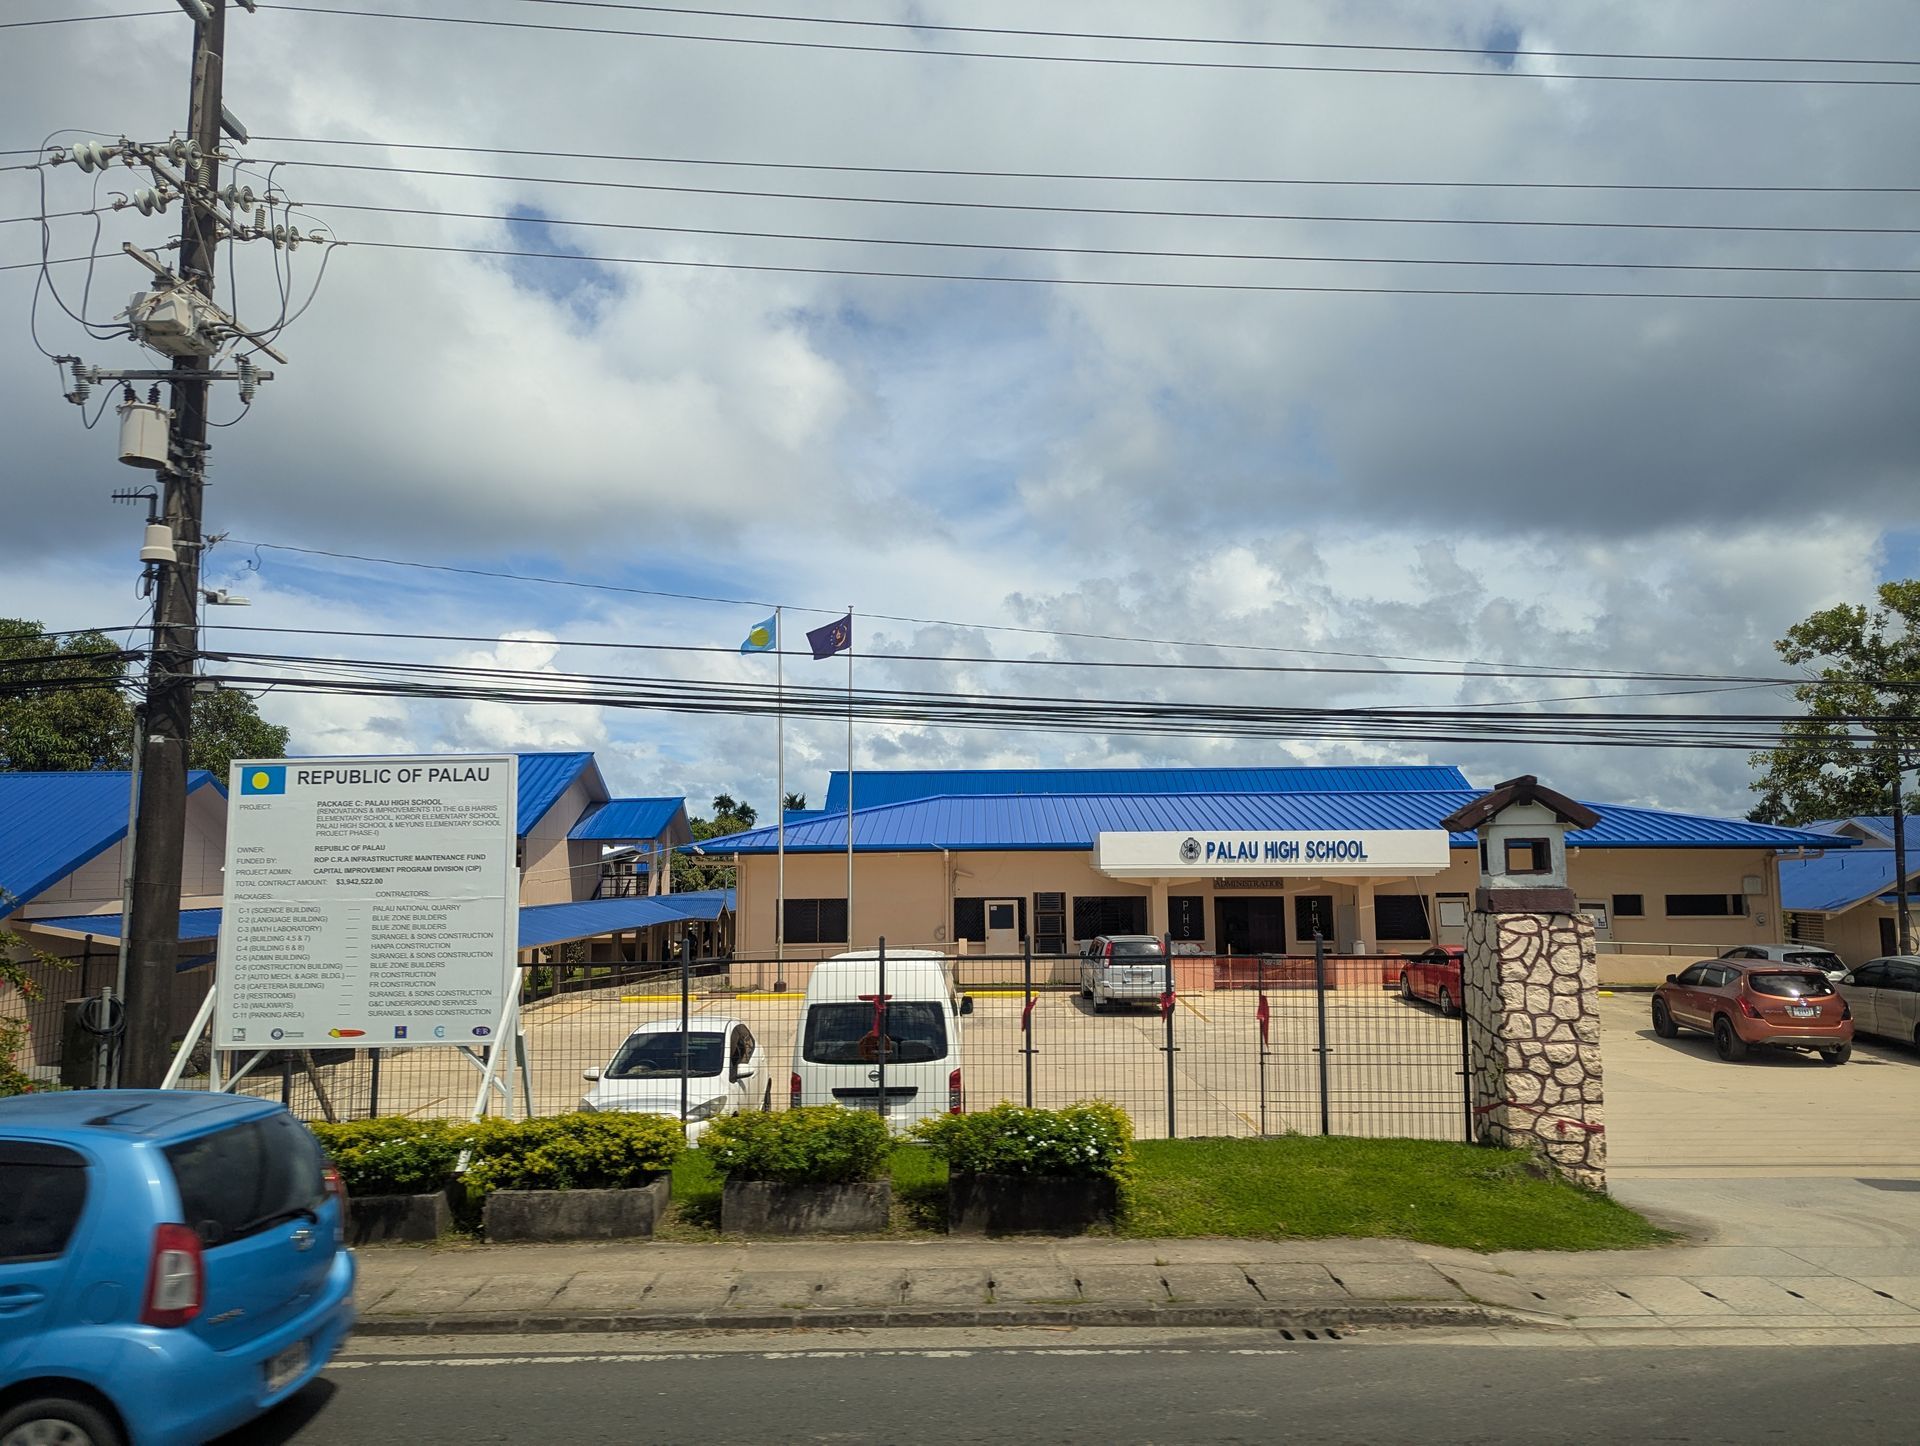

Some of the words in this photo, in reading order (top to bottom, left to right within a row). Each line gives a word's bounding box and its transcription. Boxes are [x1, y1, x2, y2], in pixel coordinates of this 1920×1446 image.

[298, 769, 391, 785] REPUBLIC
[398, 768, 422, 783] OF
[428, 767, 489, 782] PALAU
[1206, 841, 1258, 859] PALAU
[1265, 841, 1299, 859] HIGH
[1306, 841, 1368, 858] SCHOOL
[1214, 879, 1283, 888] ADMINISTRATION
